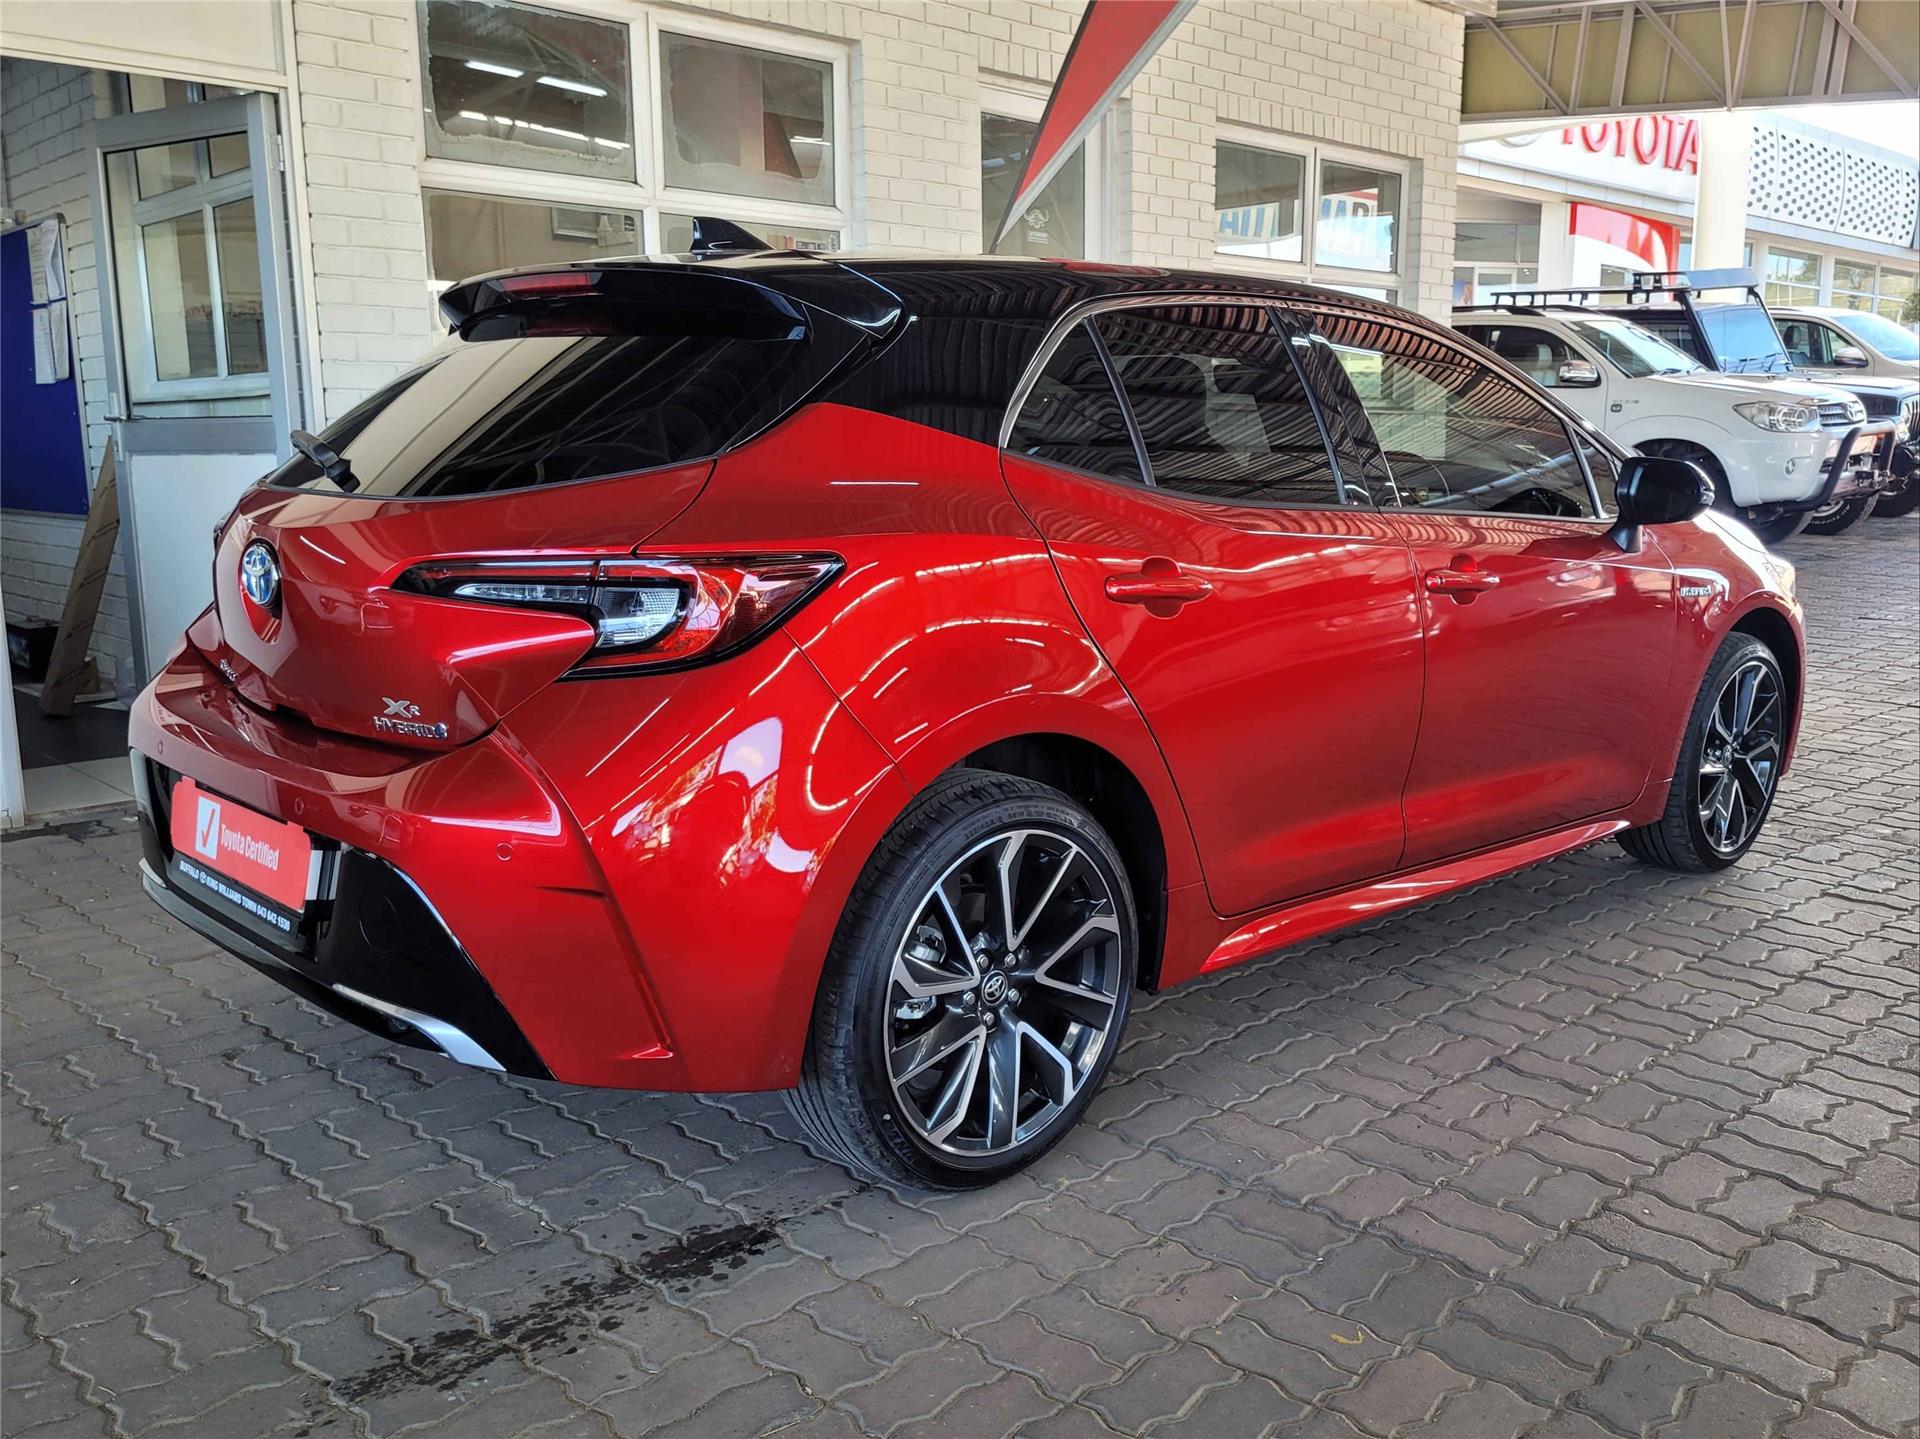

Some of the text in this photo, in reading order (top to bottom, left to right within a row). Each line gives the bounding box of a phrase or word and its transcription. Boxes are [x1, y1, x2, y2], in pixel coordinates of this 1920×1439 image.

[221, 824, 280, 871] Toyota Certified
[179, 860, 200, 880] BUFFALO
